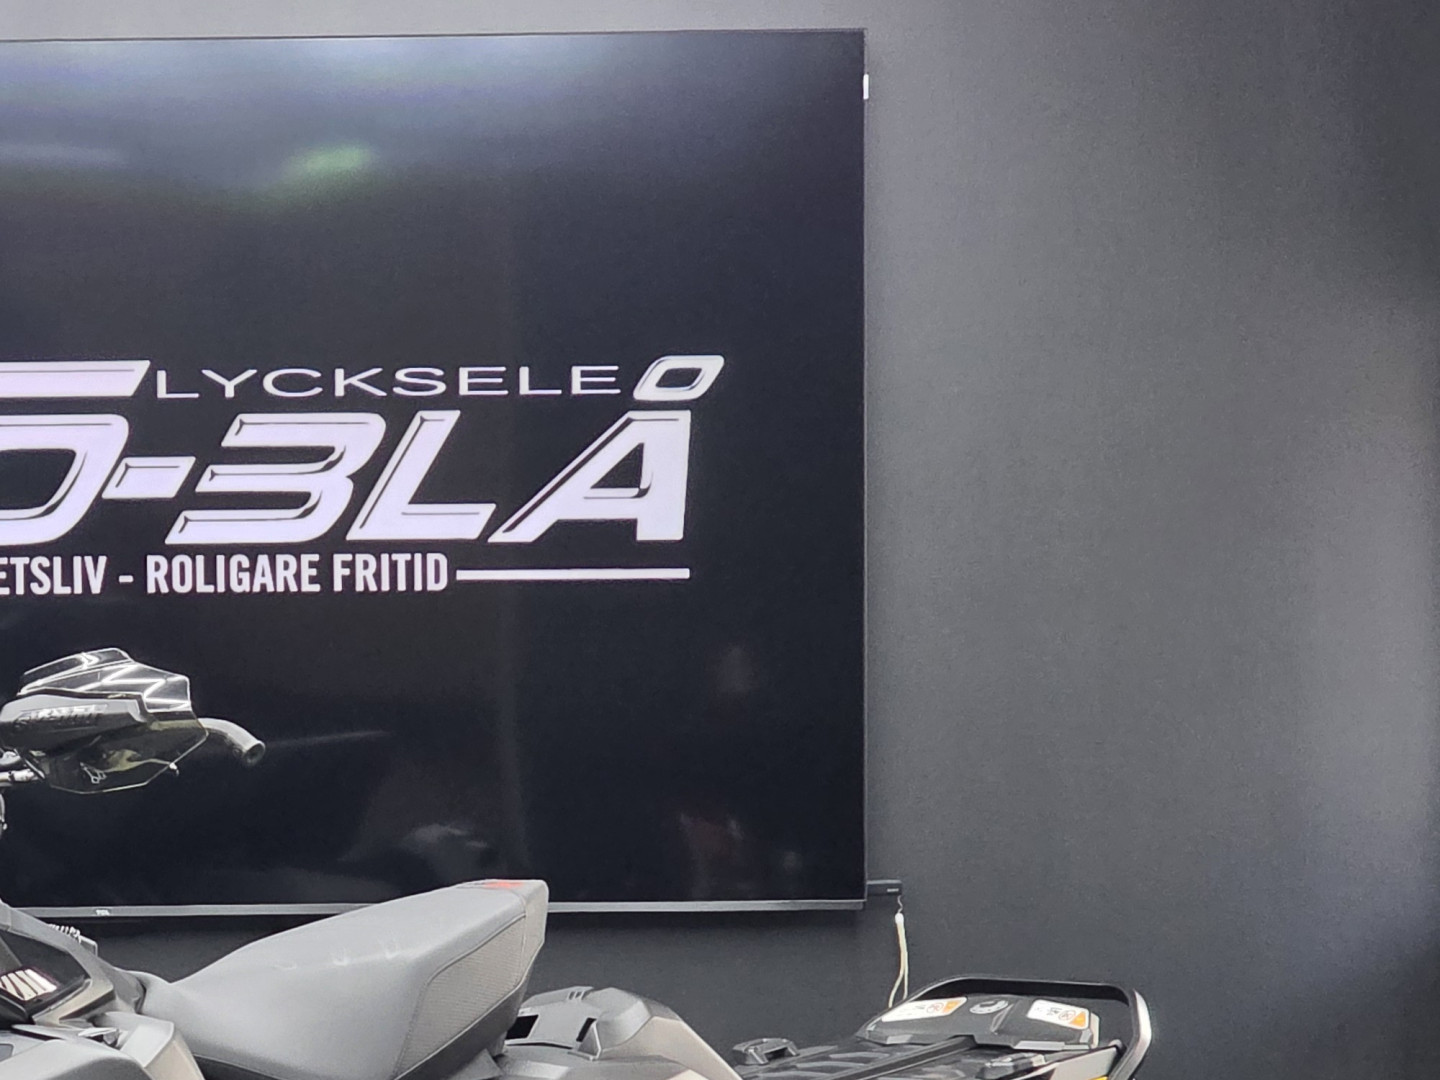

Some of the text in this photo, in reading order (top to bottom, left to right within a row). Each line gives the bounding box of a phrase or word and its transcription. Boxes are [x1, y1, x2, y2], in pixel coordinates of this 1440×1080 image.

[157, 366, 621, 399] LYCKSELE
[146, 554, 321, 594] ROLIGARE
[334, 553, 448, 592] FRITID
